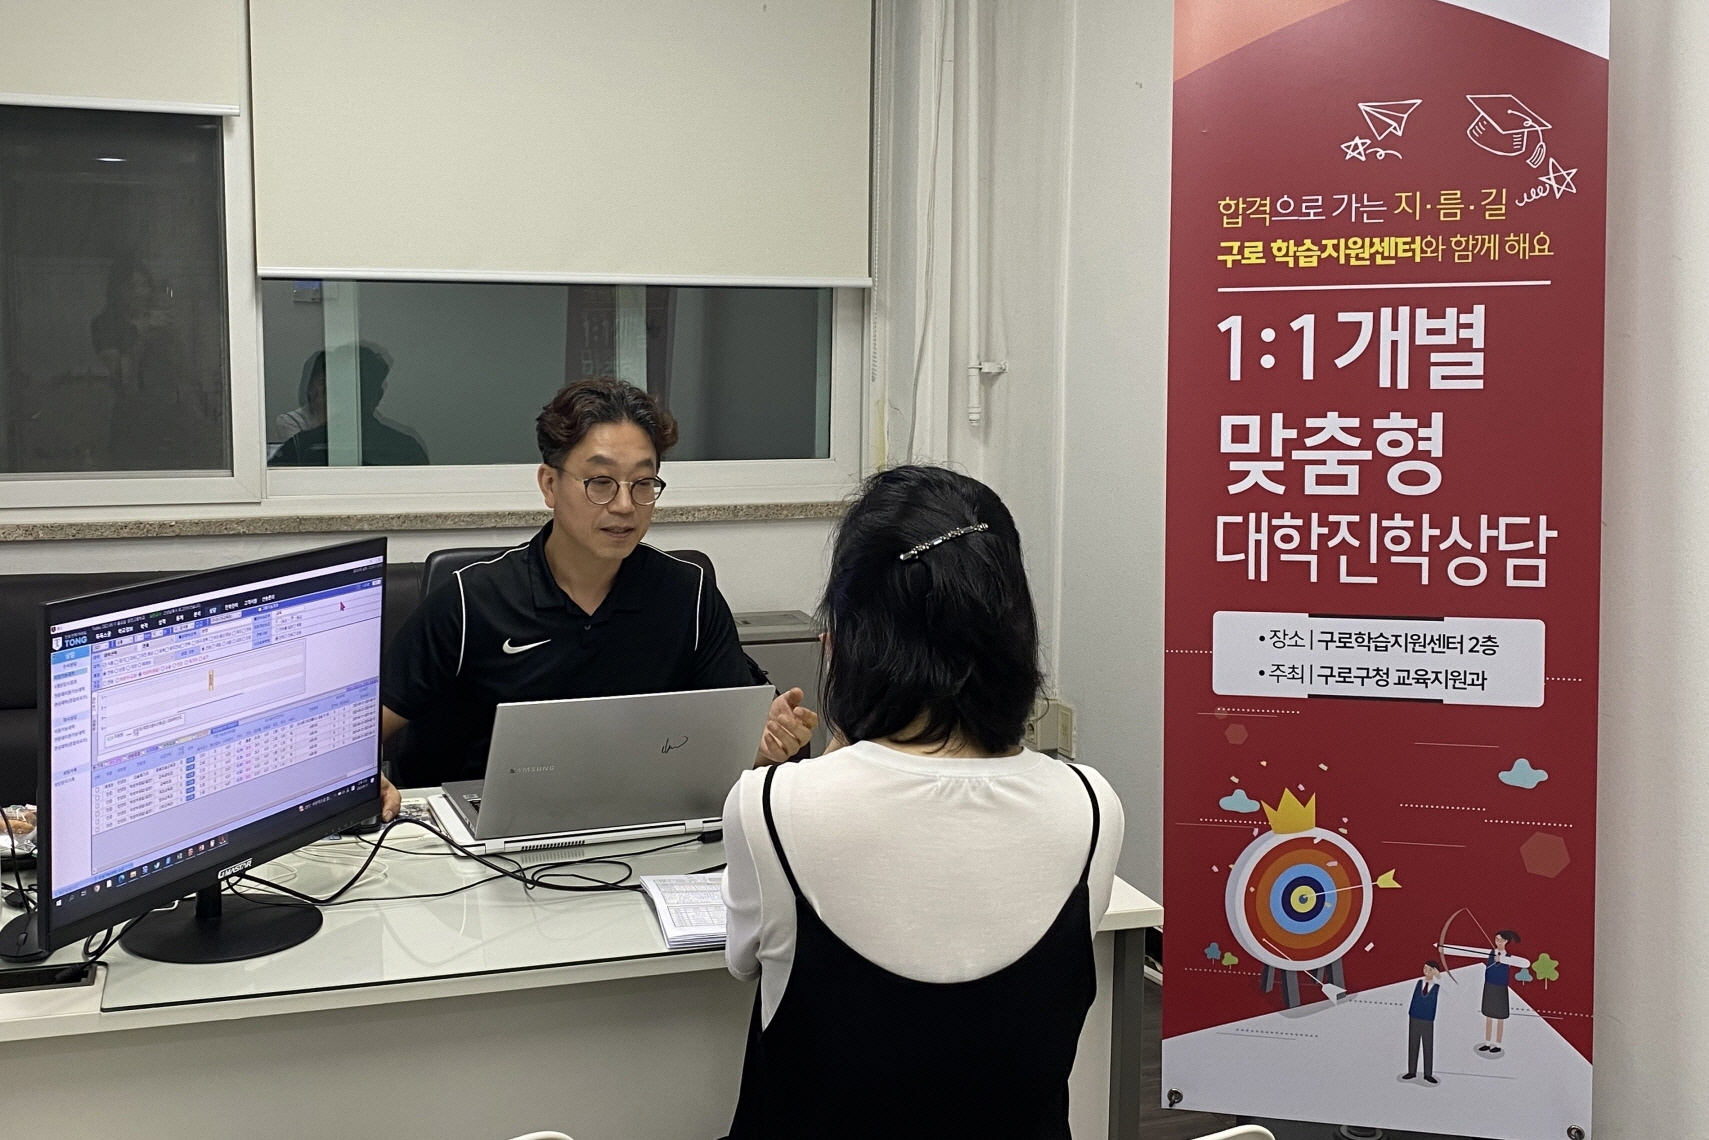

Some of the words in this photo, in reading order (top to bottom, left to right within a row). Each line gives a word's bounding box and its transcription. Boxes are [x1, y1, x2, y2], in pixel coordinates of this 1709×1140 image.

[1217, 195, 1326, 227] 합격으로
[1331, 193, 1387, 224] 가는
[1217, 240, 1266, 268] 구로
[1270, 235, 1444, 267] 학습지원센터와
[1449, 234, 1500, 263] 함께
[1504, 231, 1554, 260] 해요
[1216, 313, 1315, 382] 1:1
[1333, 304, 1485, 390] 개별
[1219, 411, 1444, 496] 맞춤형
[1216, 511, 1559, 588] 대학진학상담
[64, 636, 88, 648] TONG
[1268, 628, 1307, 650] 장소
[1316, 630, 1464, 656] 구로학습지원센터
[1468, 635, 1500, 656] 2층
[1268, 664, 1305, 685] 주최
[1316, 665, 1390, 689] 구로구청
[1393, 668, 1488, 692] 교육지원과
